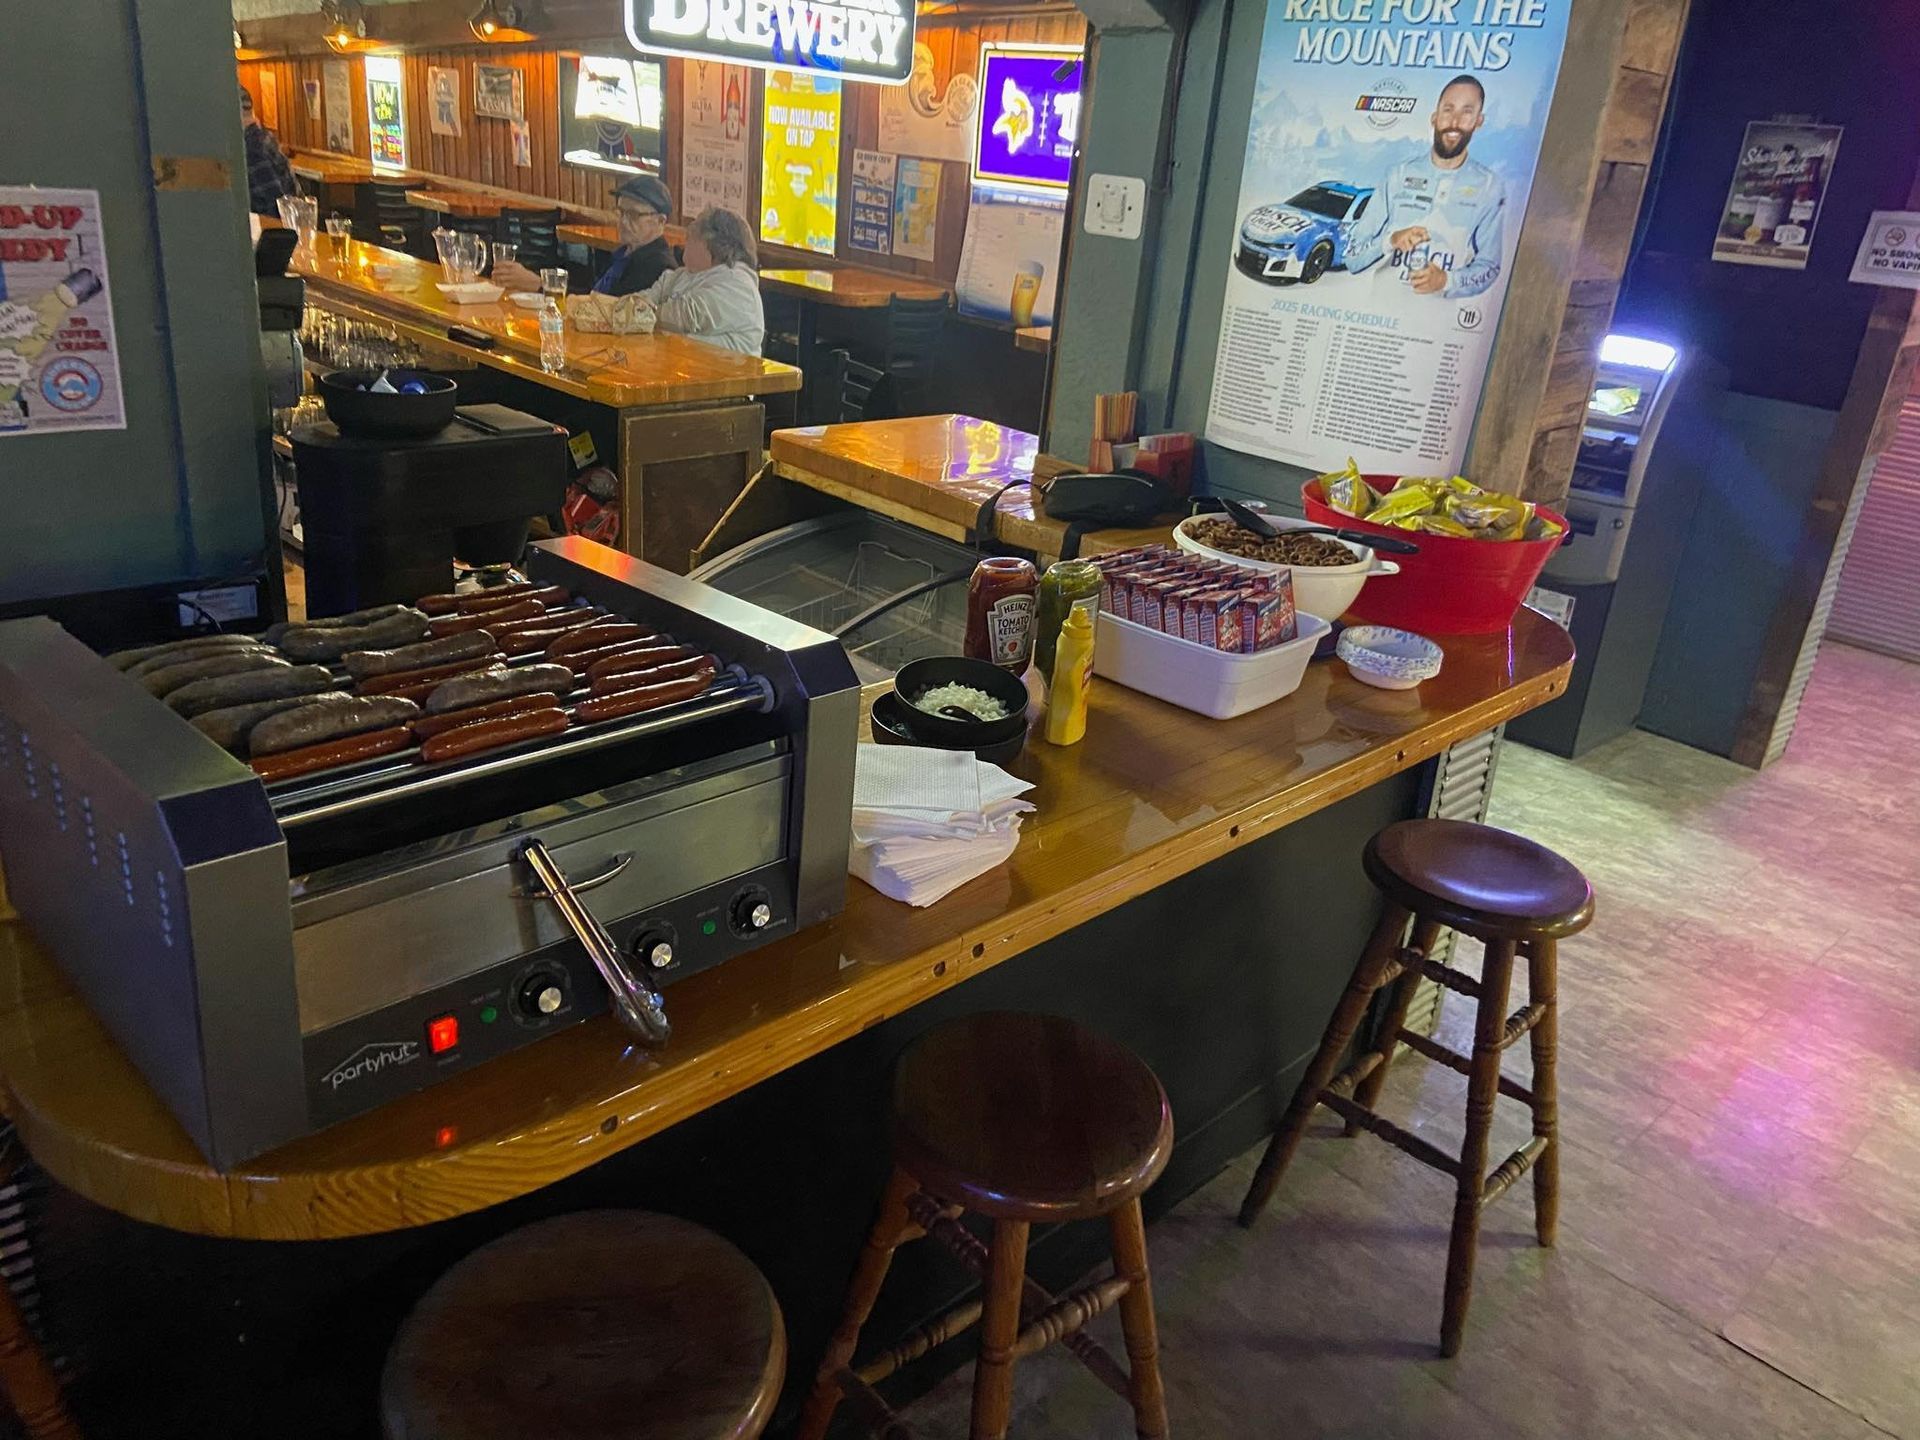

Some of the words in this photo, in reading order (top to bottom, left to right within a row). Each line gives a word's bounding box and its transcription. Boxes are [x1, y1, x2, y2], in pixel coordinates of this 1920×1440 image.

[1283, 0, 1370, 23] RACE
[1379, 0, 1457, 25] FOR
[1471, 0, 1545, 27] THE
[648, 0, 905, 66] BREWERY
[1294, 27, 1514, 71] MOUNTAINS
[1369, 97, 1416, 112] NASCAR
[768, 105, 788, 124] NOW
[789, 110, 835, 132] AVAILABLE
[786, 128, 798, 146] ON
[799, 129, 815, 148] TAP
[1250, 205, 1312, 232] BUSCH
[1391, 247, 1454, 271] BUCH
[1871, 248, 1887, 256] NO
[1873, 258, 1889, 267] NO
[1271, 299, 1299, 313] 2025
[1300, 303, 1342, 320] RACING
[1343, 310, 1400, 329] SCHEDULE
[1003, 602, 1027, 613] HEINZ
[997, 615, 1029, 628] TOMATO
[332, 1044, 411, 1089] partyhut
